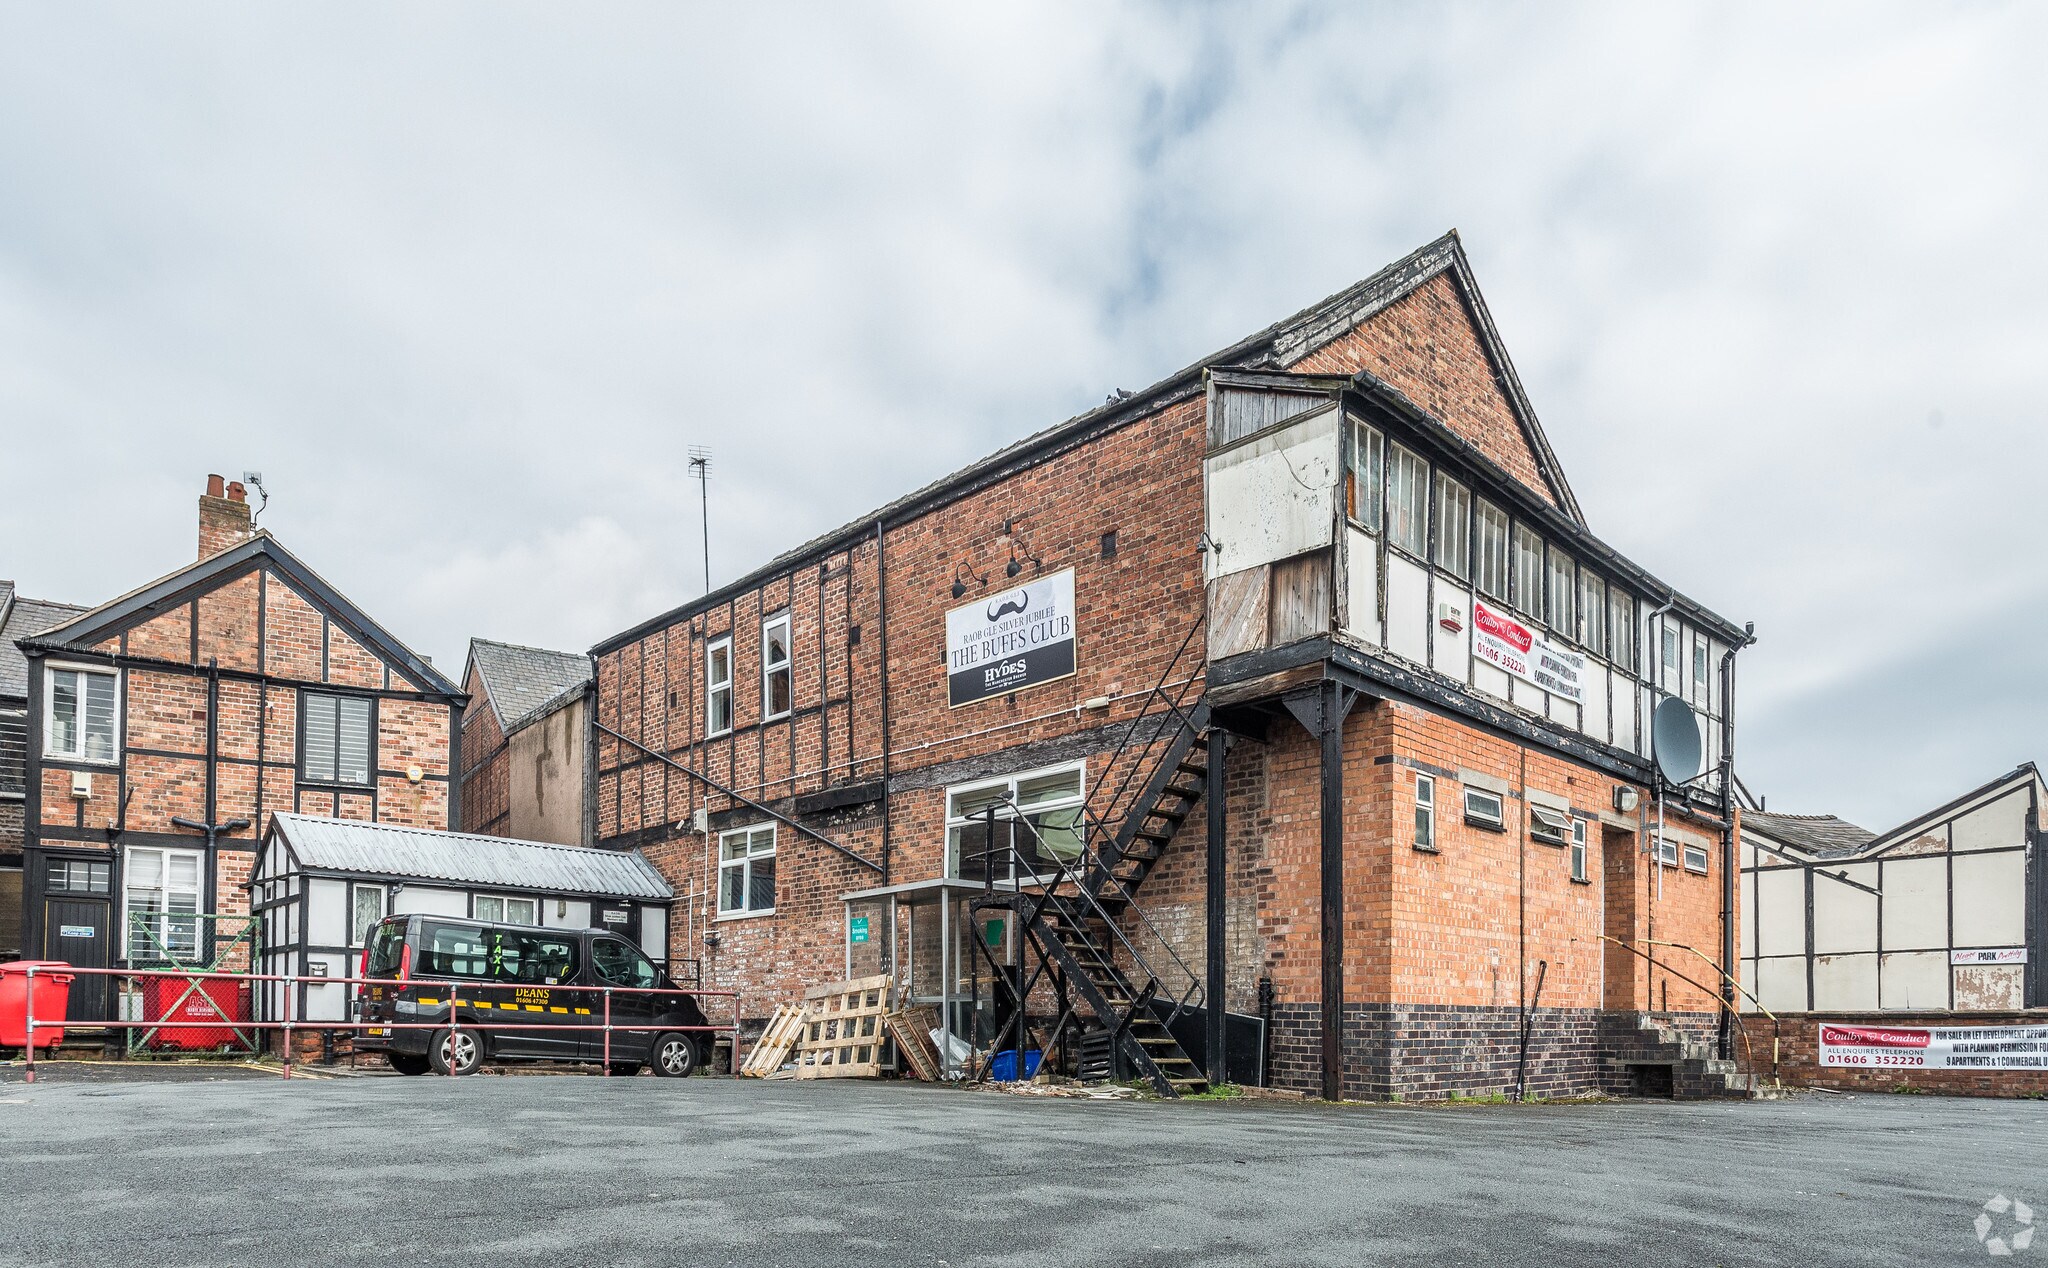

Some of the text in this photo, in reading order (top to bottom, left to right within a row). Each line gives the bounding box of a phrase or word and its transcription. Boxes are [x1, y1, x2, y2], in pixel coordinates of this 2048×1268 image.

[963, 606, 1055, 644] RAOB GLE SILVER JUBILEE
[952, 615, 1070, 668] THE BUFFS CLUB
[1506, 626, 1530, 646] Conduct
[1478, 642, 1526, 674] 01606 352220
[985, 659, 1026, 682] HYDES
[493, 935, 502, 974] TAXI
[1978, 952, 1996, 960] PARK
[516, 988, 550, 998] DEANS
[1826, 1031, 1927, 1043] Coulby Conduct
[1936, 1031, 1947, 1040] FOR
[1948, 1031, 1962, 1039] SALE
[1963, 1031, 1971, 1039] OR
[1972, 1031, 1982, 1039] LET
[1983, 1030, 2024, 1039] DEVELOPMENT
[1953, 1043, 1968, 1052] WITH
[1970, 1043, 1999, 1052] PLANNING
[2000, 1043, 2038, 1052] PERMISSION
[1828, 1055, 1924, 1065] 01606 352220
[1946, 1057, 1951, 1066] 9
[1952, 1056, 1990, 1066] APARTMENTS
[1997, 1057, 2000, 1066] 1
[2001, 1056, 2042, 1066] COMMERCIAL
